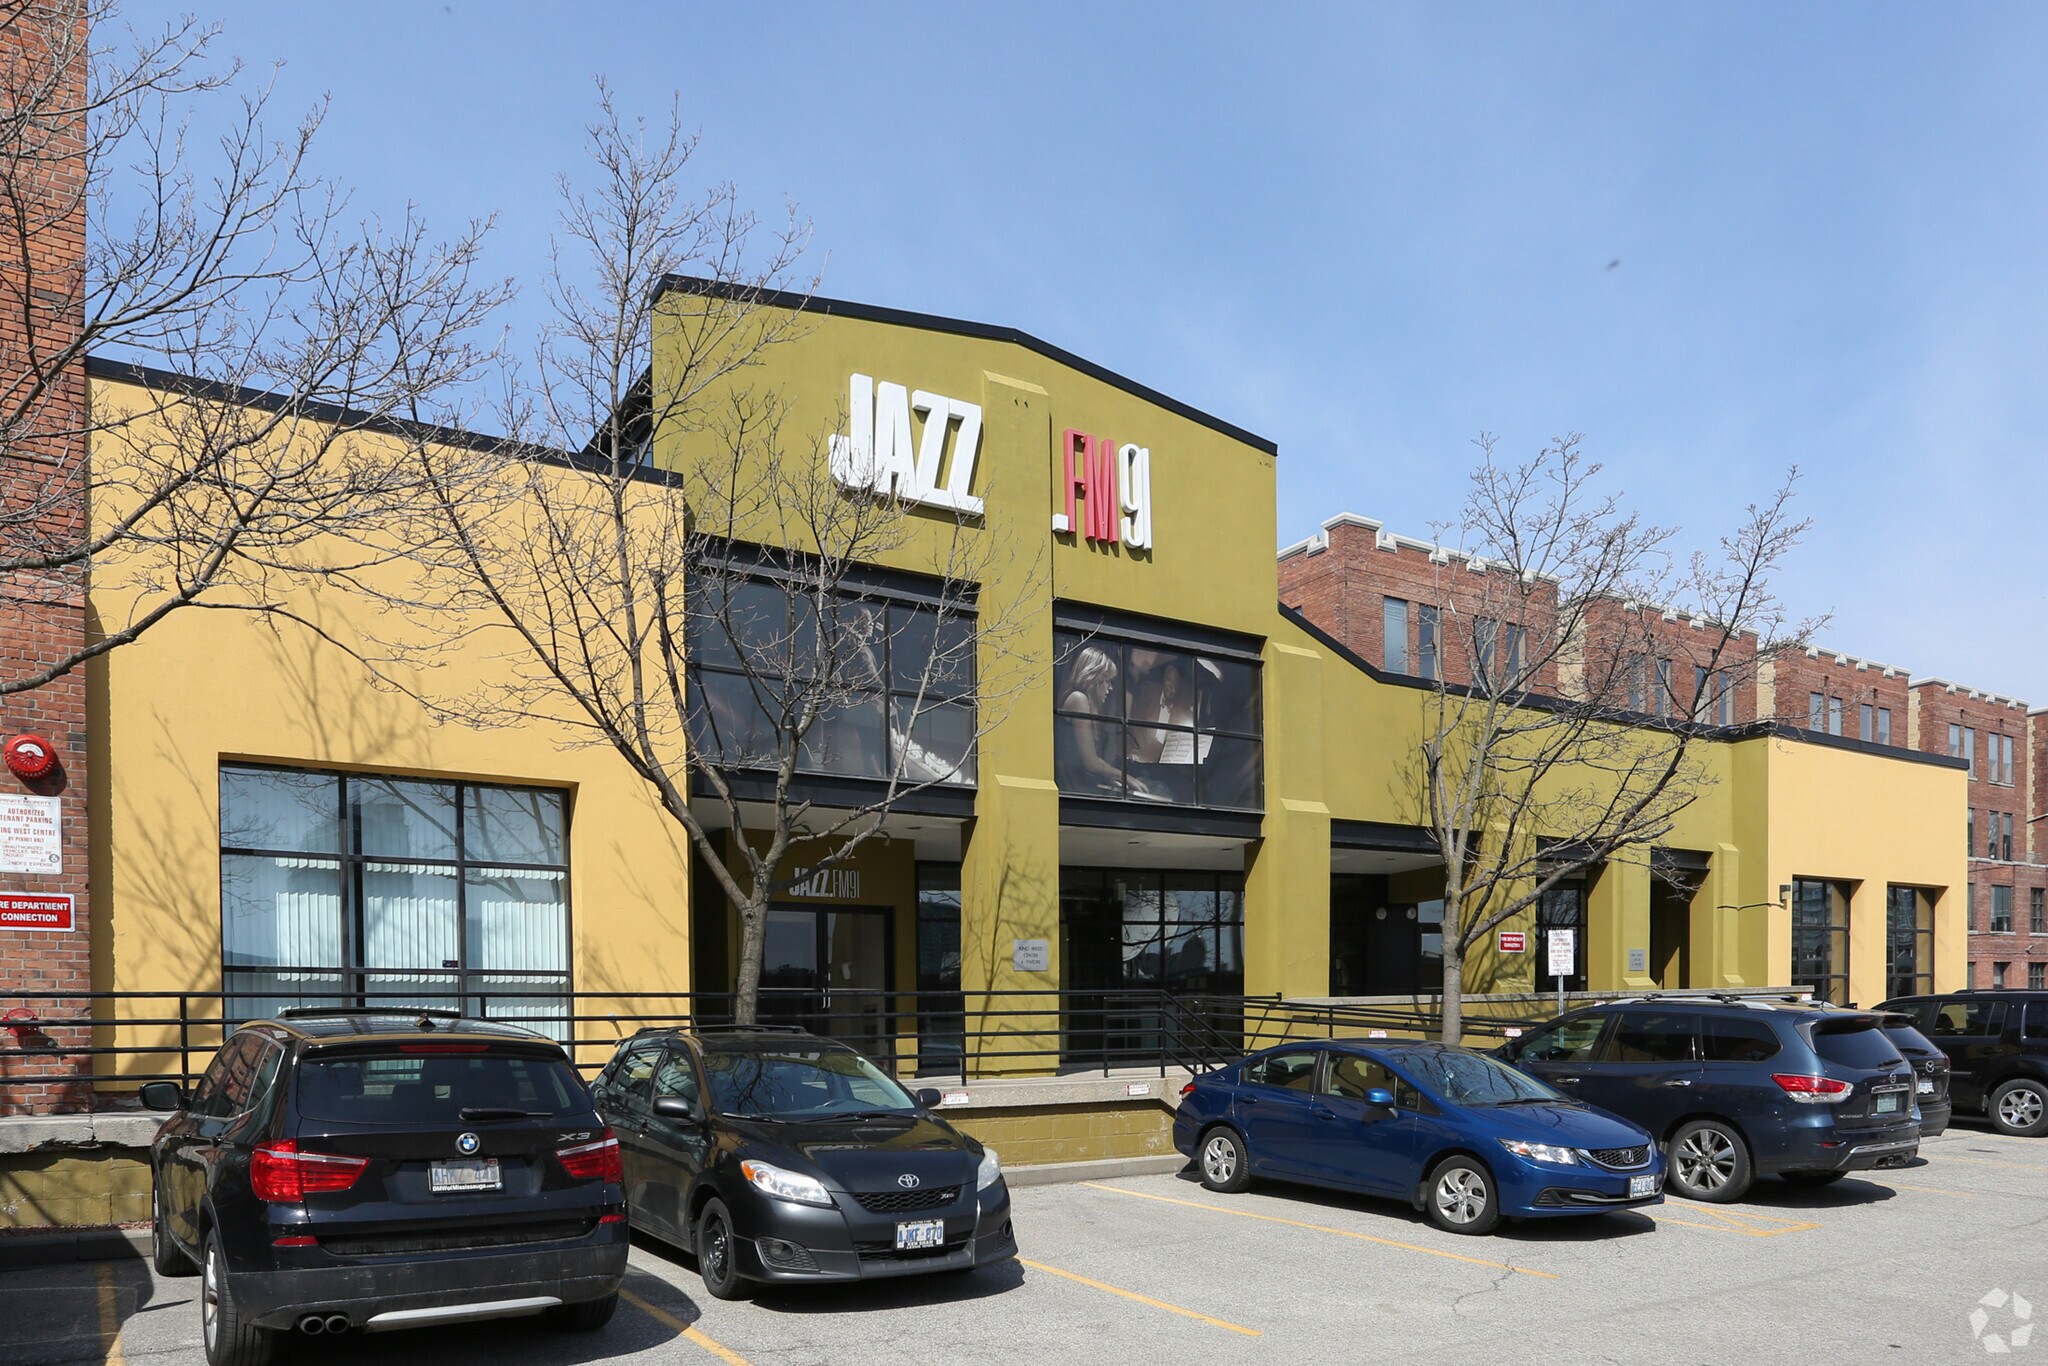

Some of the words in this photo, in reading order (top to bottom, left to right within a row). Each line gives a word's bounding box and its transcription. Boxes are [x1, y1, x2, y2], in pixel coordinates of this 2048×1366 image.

[828, 372, 984, 515] JAZZ
[7, 808, 45, 816] AUTHORIZED
[0, 814, 24, 822] TENANT
[25, 816, 53, 825] PARKING
[13, 827, 31, 835] WEST
[32, 829, 56, 837] CENTRE
[11, 900, 69, 911] DEPARTMENT
[1, 912, 58, 922] CONNECTION
[557, 1132, 591, 1142] X3
[926, 1226, 943, 1240] 870
